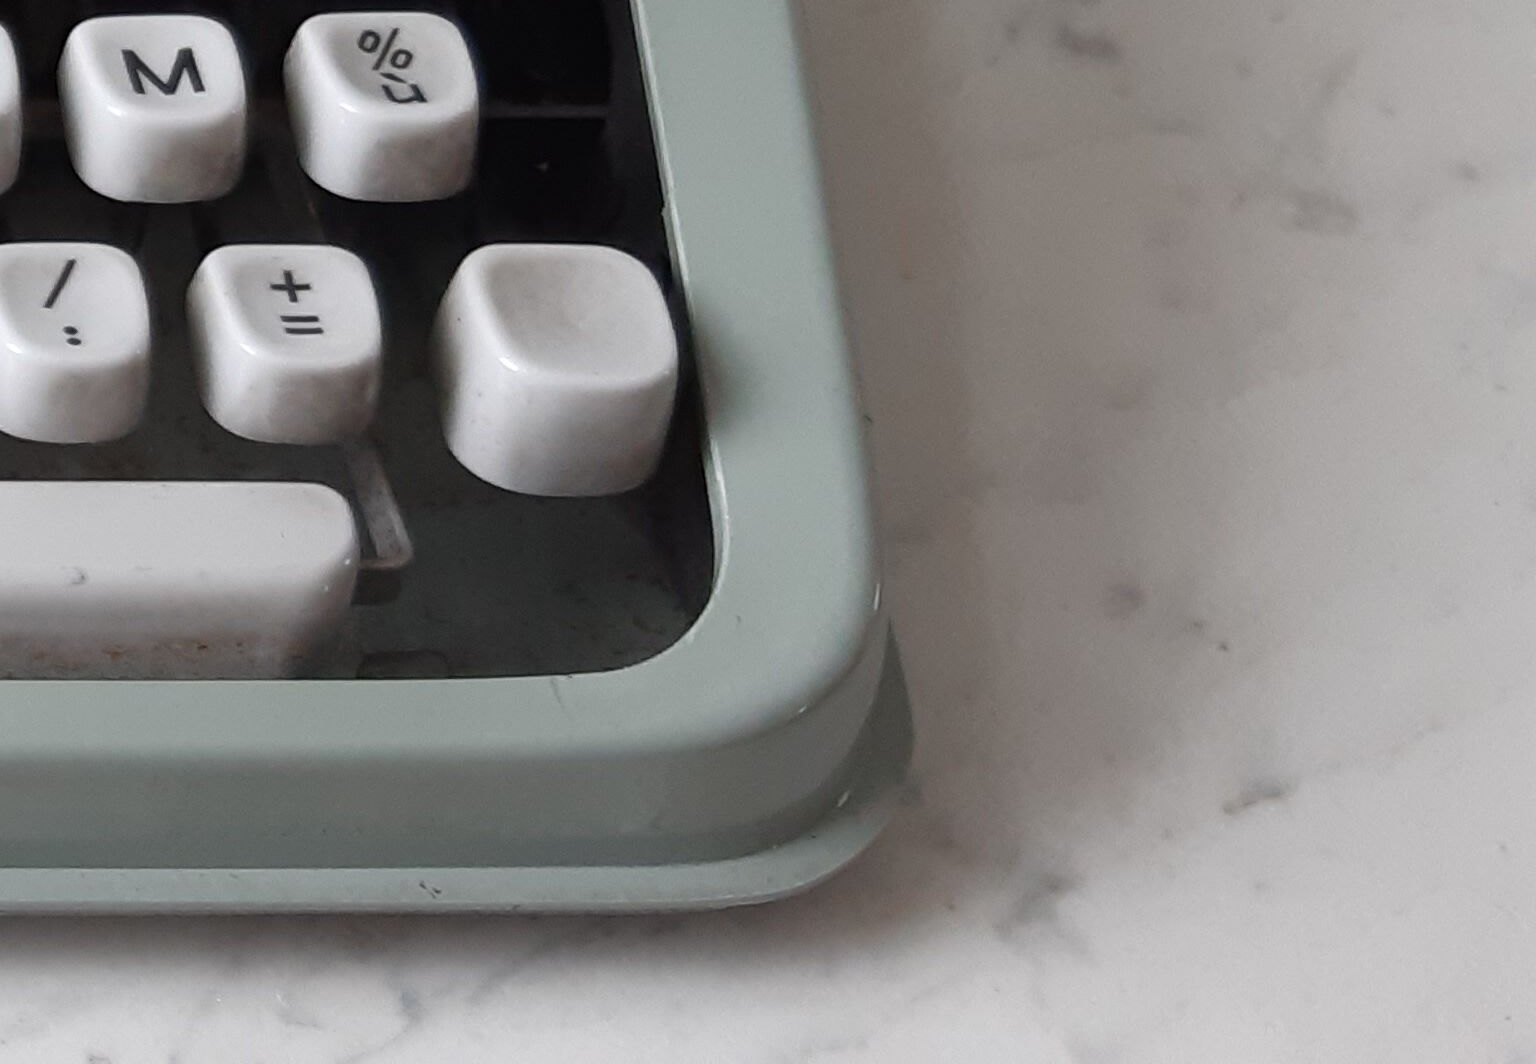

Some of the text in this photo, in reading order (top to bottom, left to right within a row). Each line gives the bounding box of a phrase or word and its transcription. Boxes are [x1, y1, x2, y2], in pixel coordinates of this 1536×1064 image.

[357, 28, 414, 71] %
[122, 48, 205, 95] M
[380, 73, 427, 104] ù
[43, 259, 76, 308] /
[270, 270, 311, 302] +
[64, 326, 81, 345] :
[280, 316, 324, 334] =
